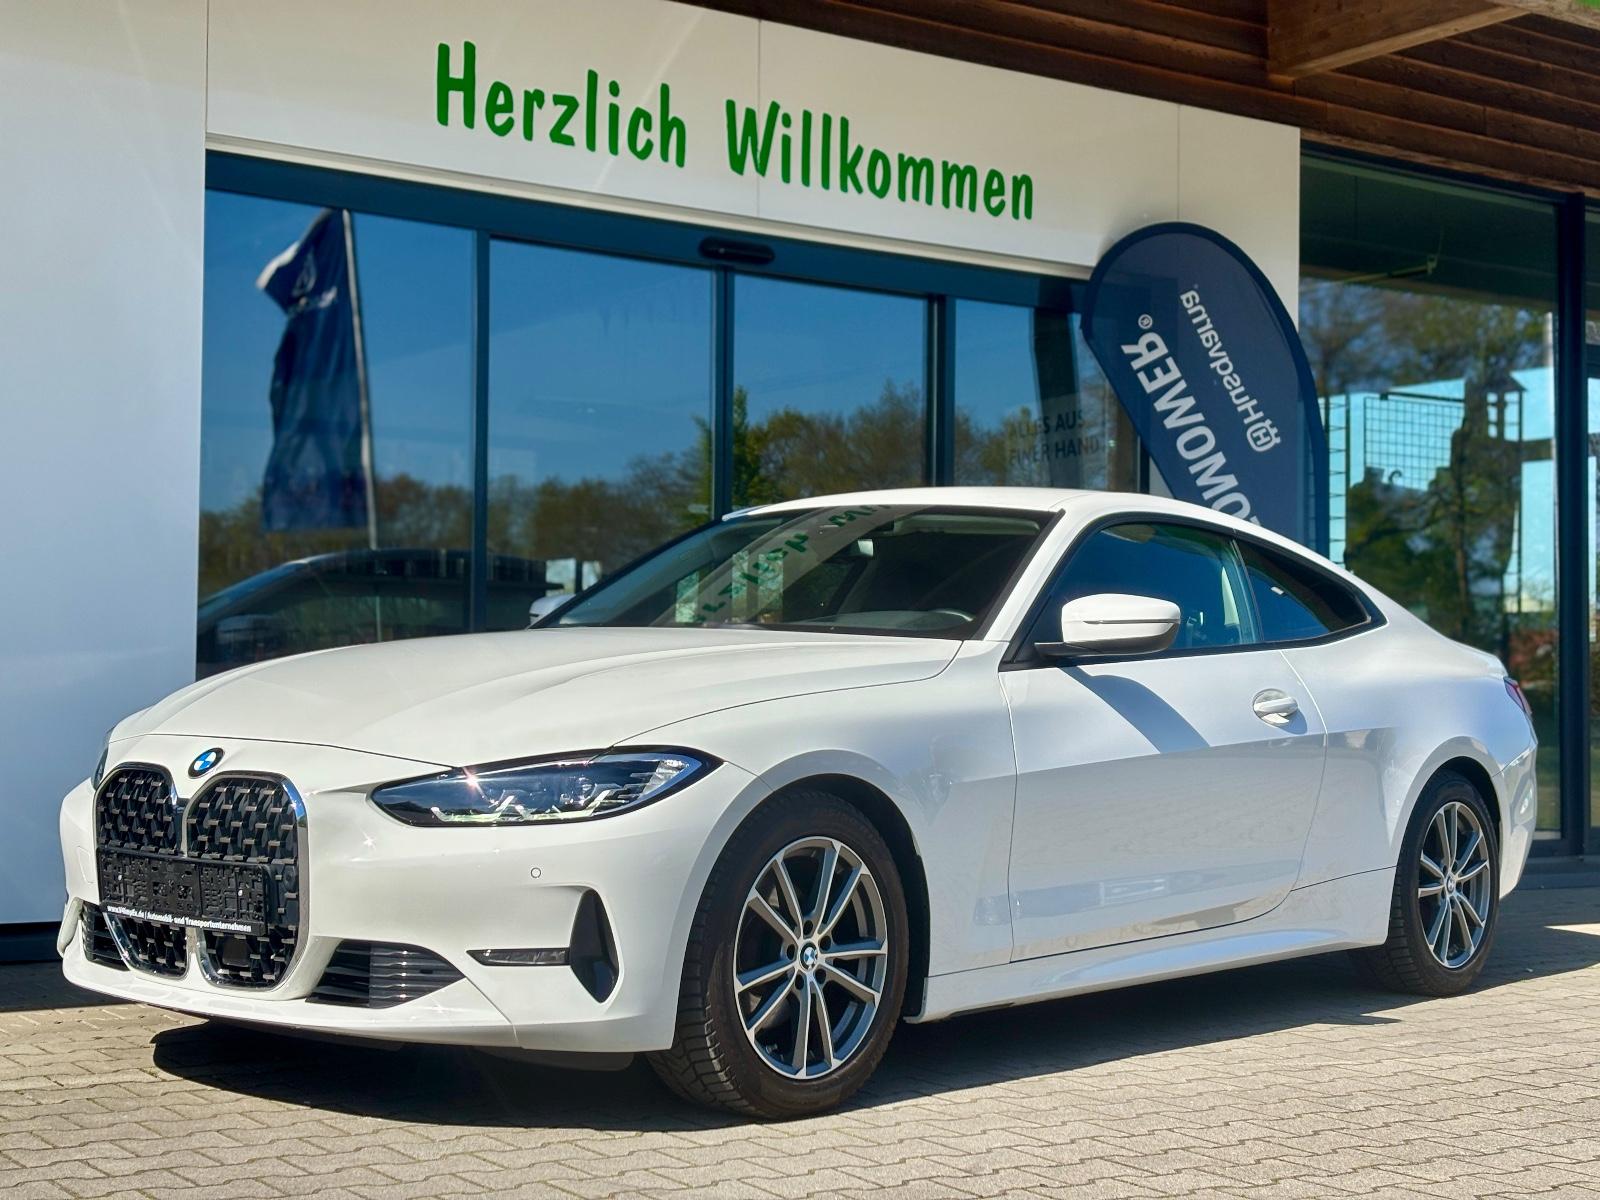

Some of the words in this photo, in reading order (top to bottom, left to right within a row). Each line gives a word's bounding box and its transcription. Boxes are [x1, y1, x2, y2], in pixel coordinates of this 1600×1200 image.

[436, 41, 687, 168] Herzlich
[726, 99, 1034, 220] Willkommen
[173, 916, 184, 925] und
